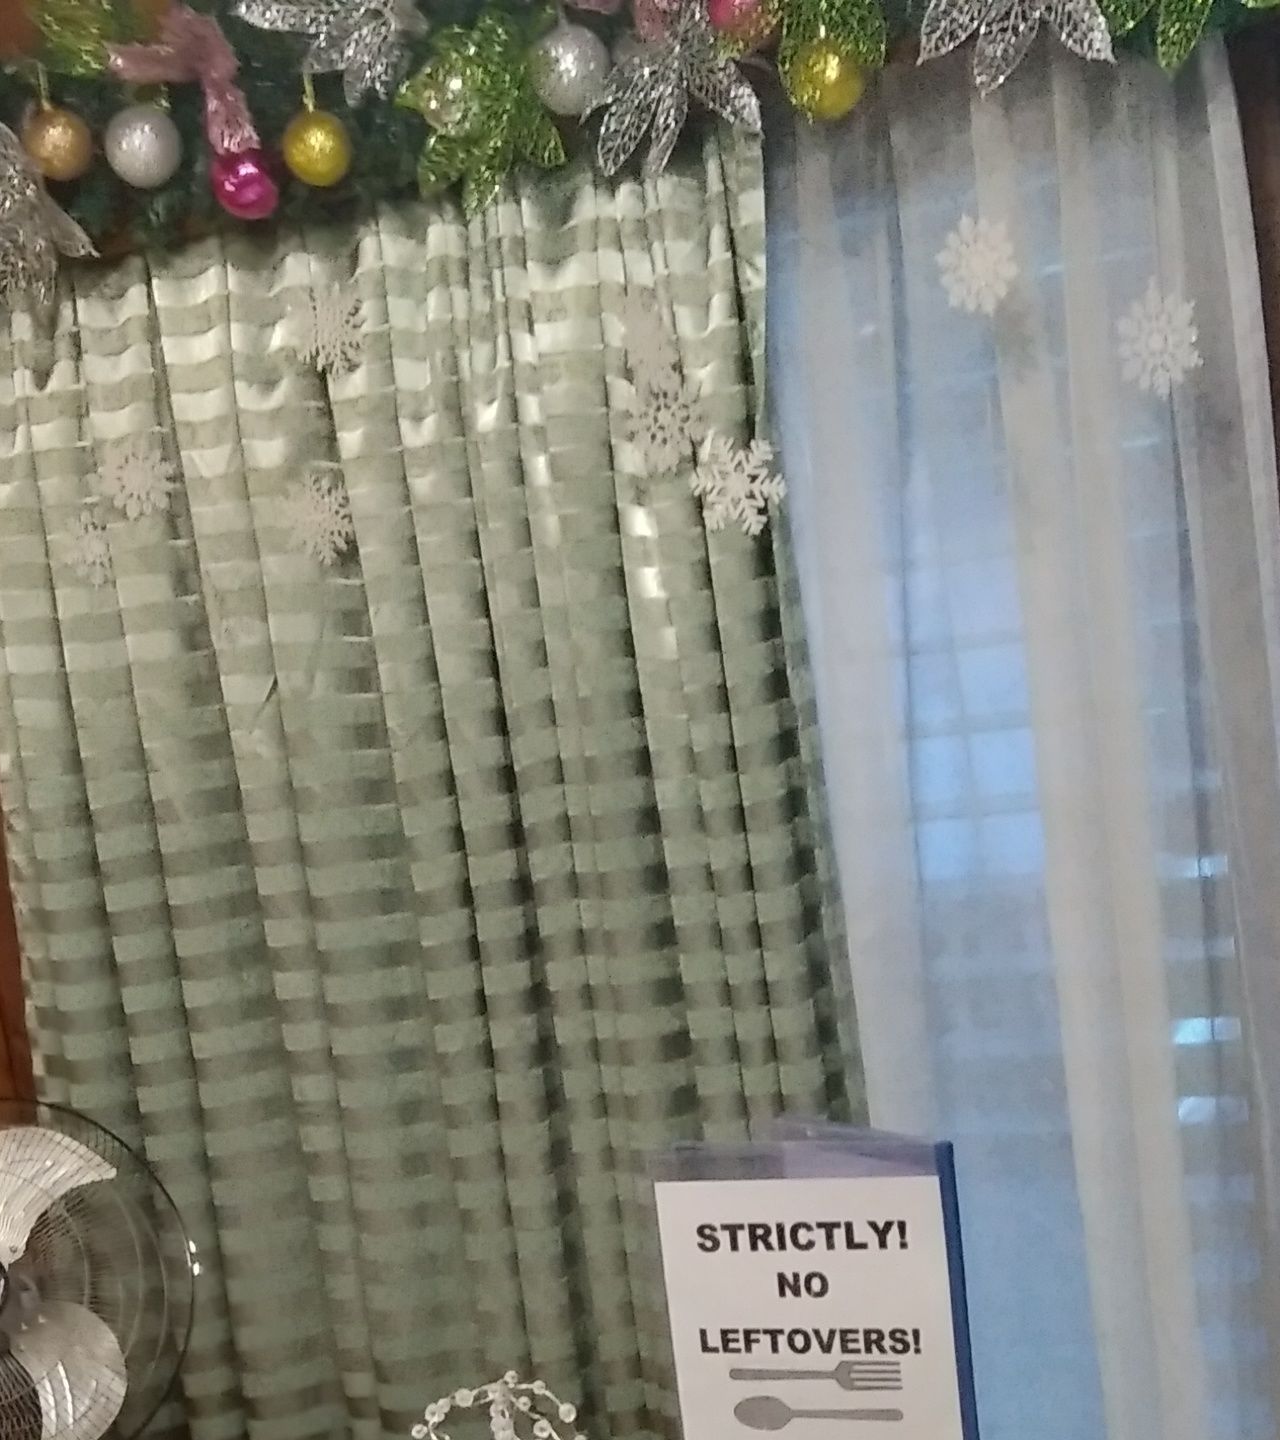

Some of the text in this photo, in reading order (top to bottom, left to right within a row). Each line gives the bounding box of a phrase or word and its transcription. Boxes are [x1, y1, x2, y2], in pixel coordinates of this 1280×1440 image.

[696, 1220, 908, 1253] STRICTLY!
[776, 1271, 829, 1299] NO
[698, 1328, 922, 1354] LEFTOVERS!
